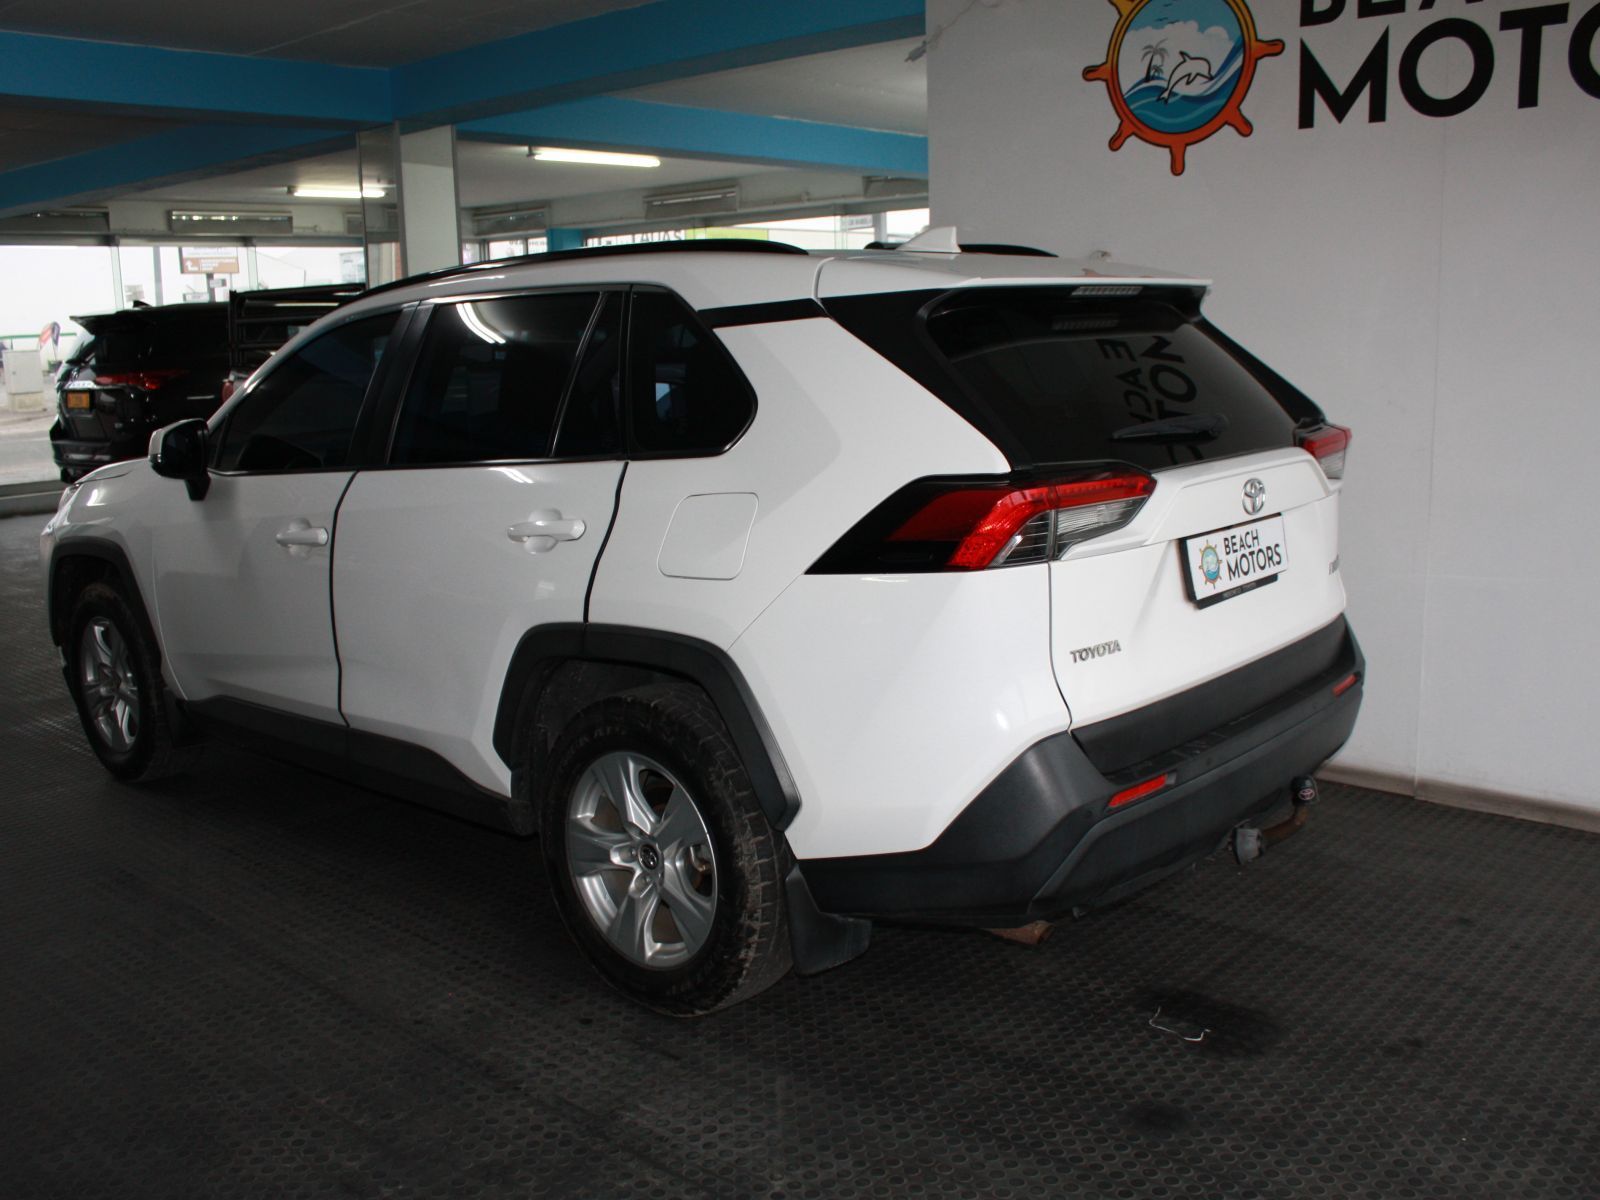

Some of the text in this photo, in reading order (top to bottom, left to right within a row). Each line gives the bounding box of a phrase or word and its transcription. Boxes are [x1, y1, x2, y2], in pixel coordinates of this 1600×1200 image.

[1223, 528, 1260, 555] BEACH
[1226, 543, 1282, 581] MOTORS
[1069, 639, 1122, 664] TOYOTA
